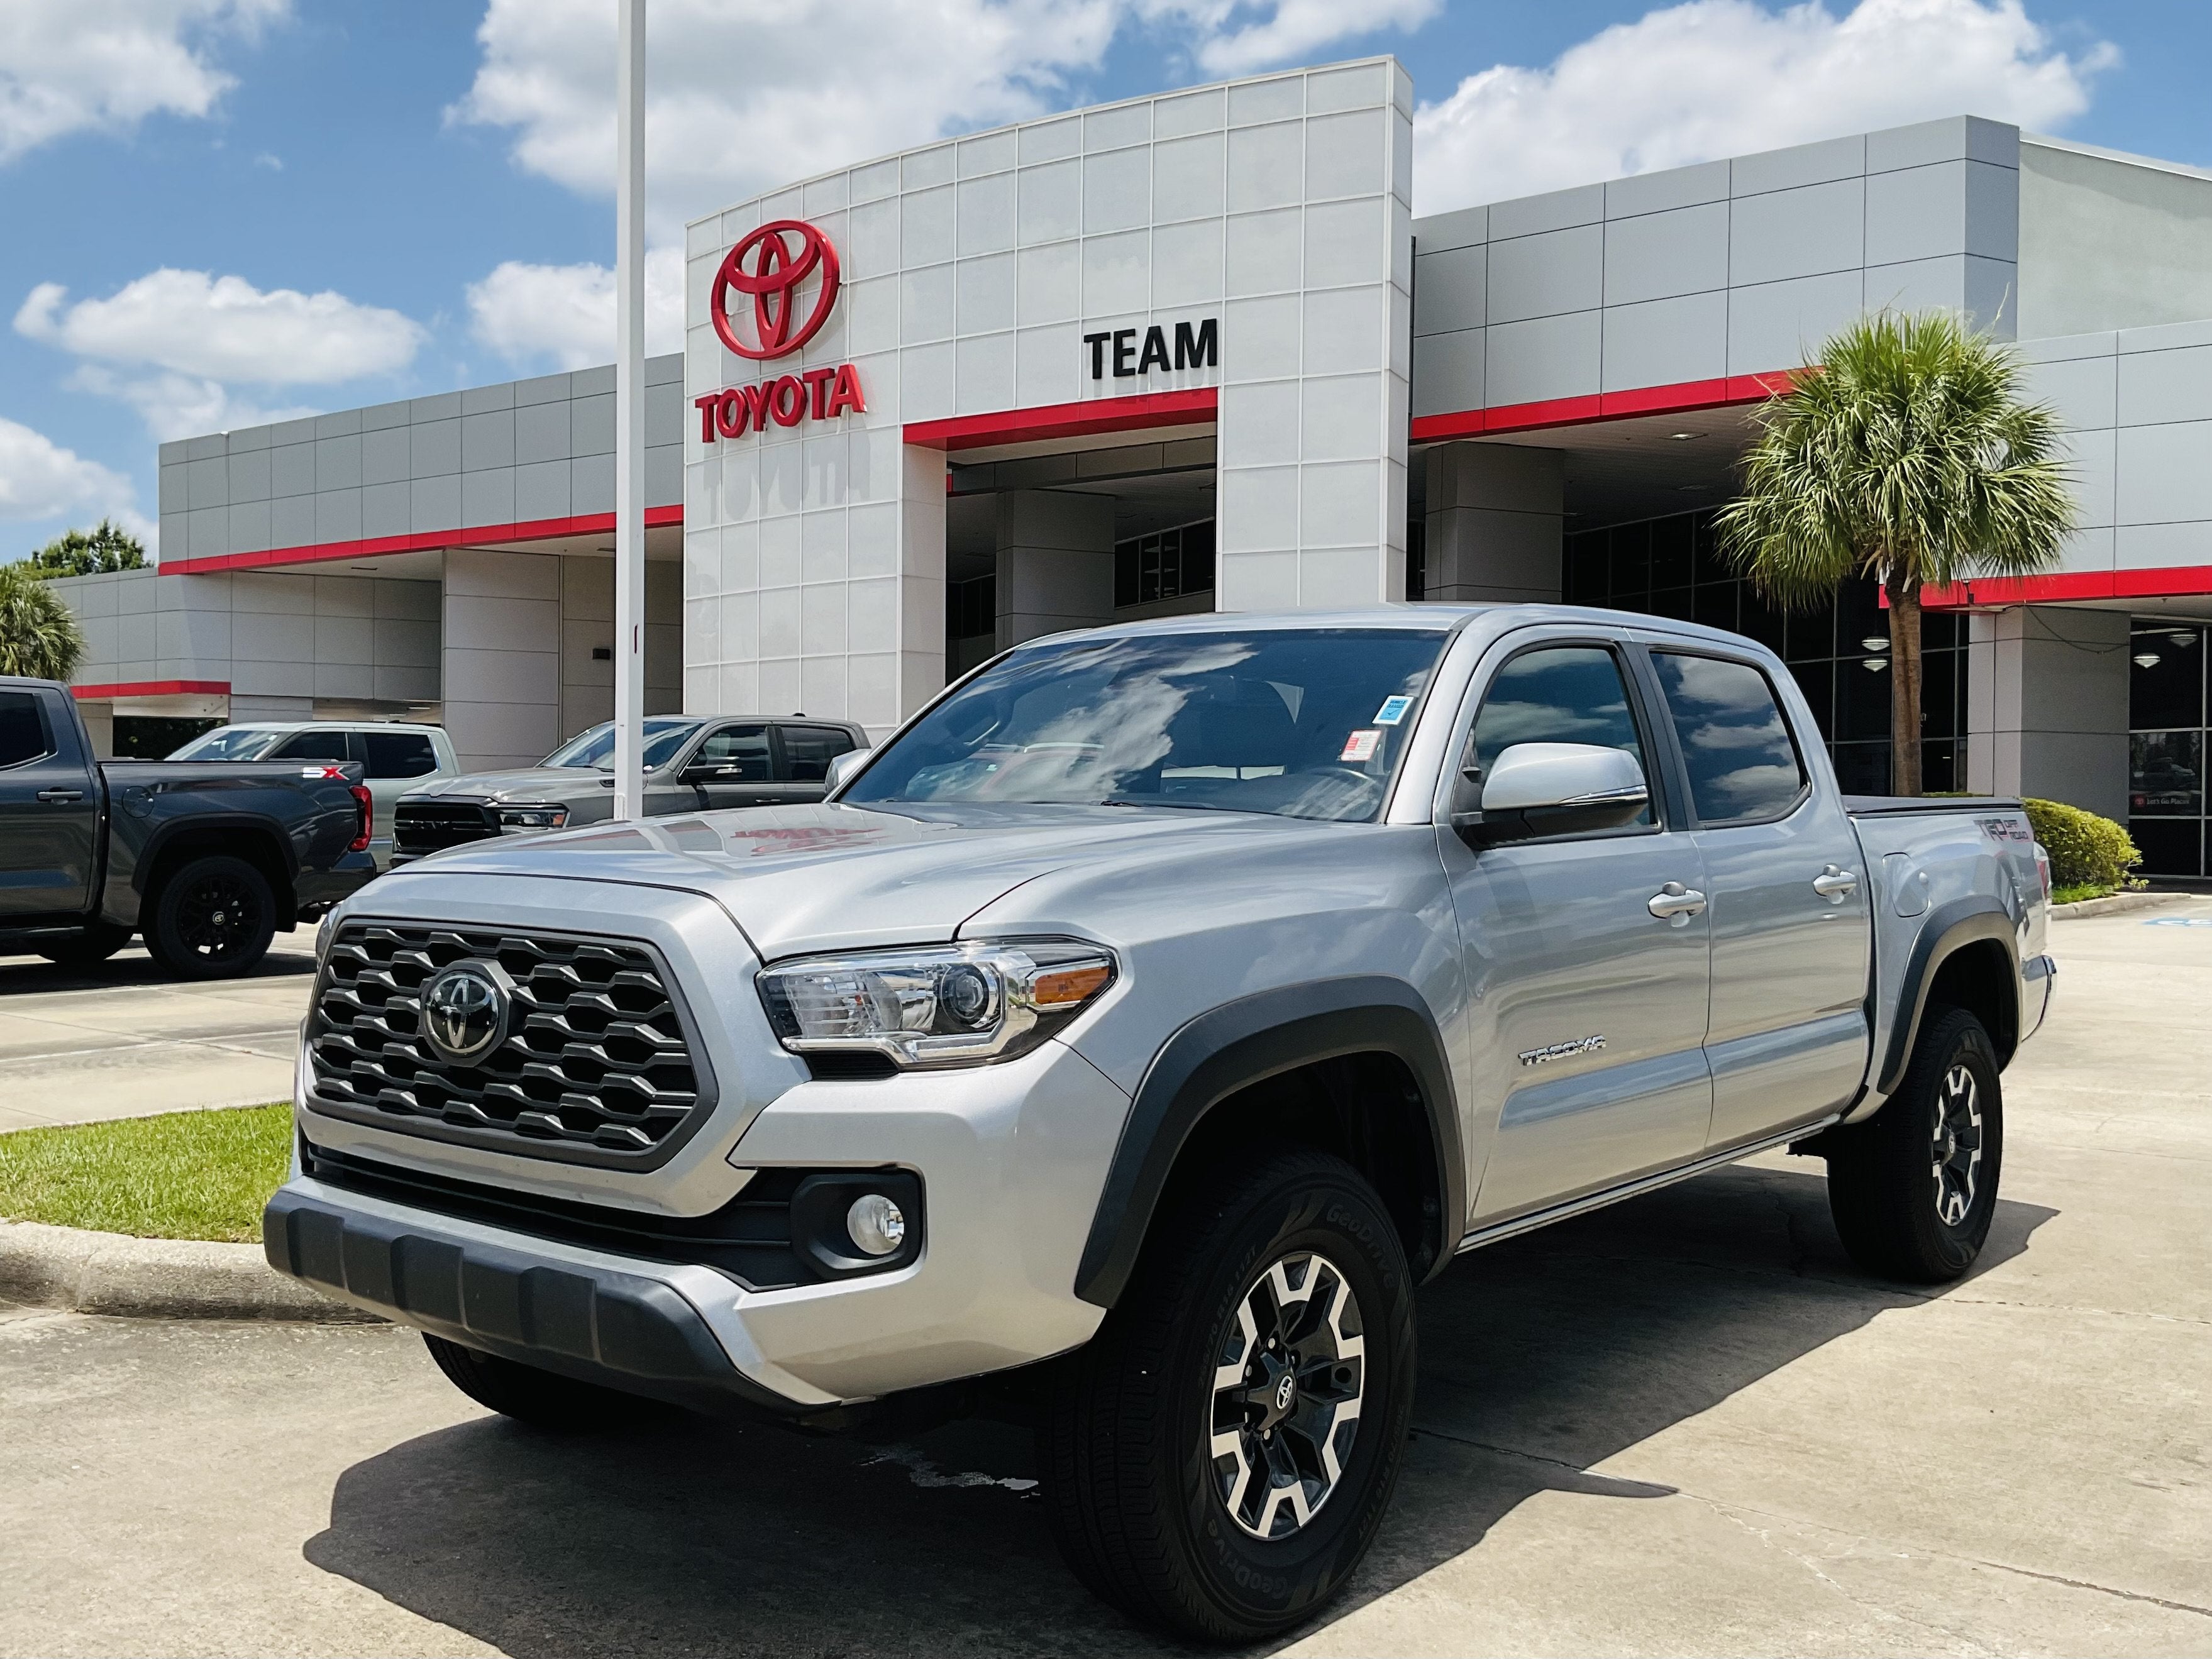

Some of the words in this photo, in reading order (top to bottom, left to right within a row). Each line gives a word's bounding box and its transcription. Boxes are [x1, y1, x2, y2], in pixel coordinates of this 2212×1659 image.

[1083, 318, 1217, 379] TEAM
[695, 363, 867, 443] TOYOTA
[1973, 819, 2007, 841] TRD
[1517, 1034, 1607, 1066] TACOMA
